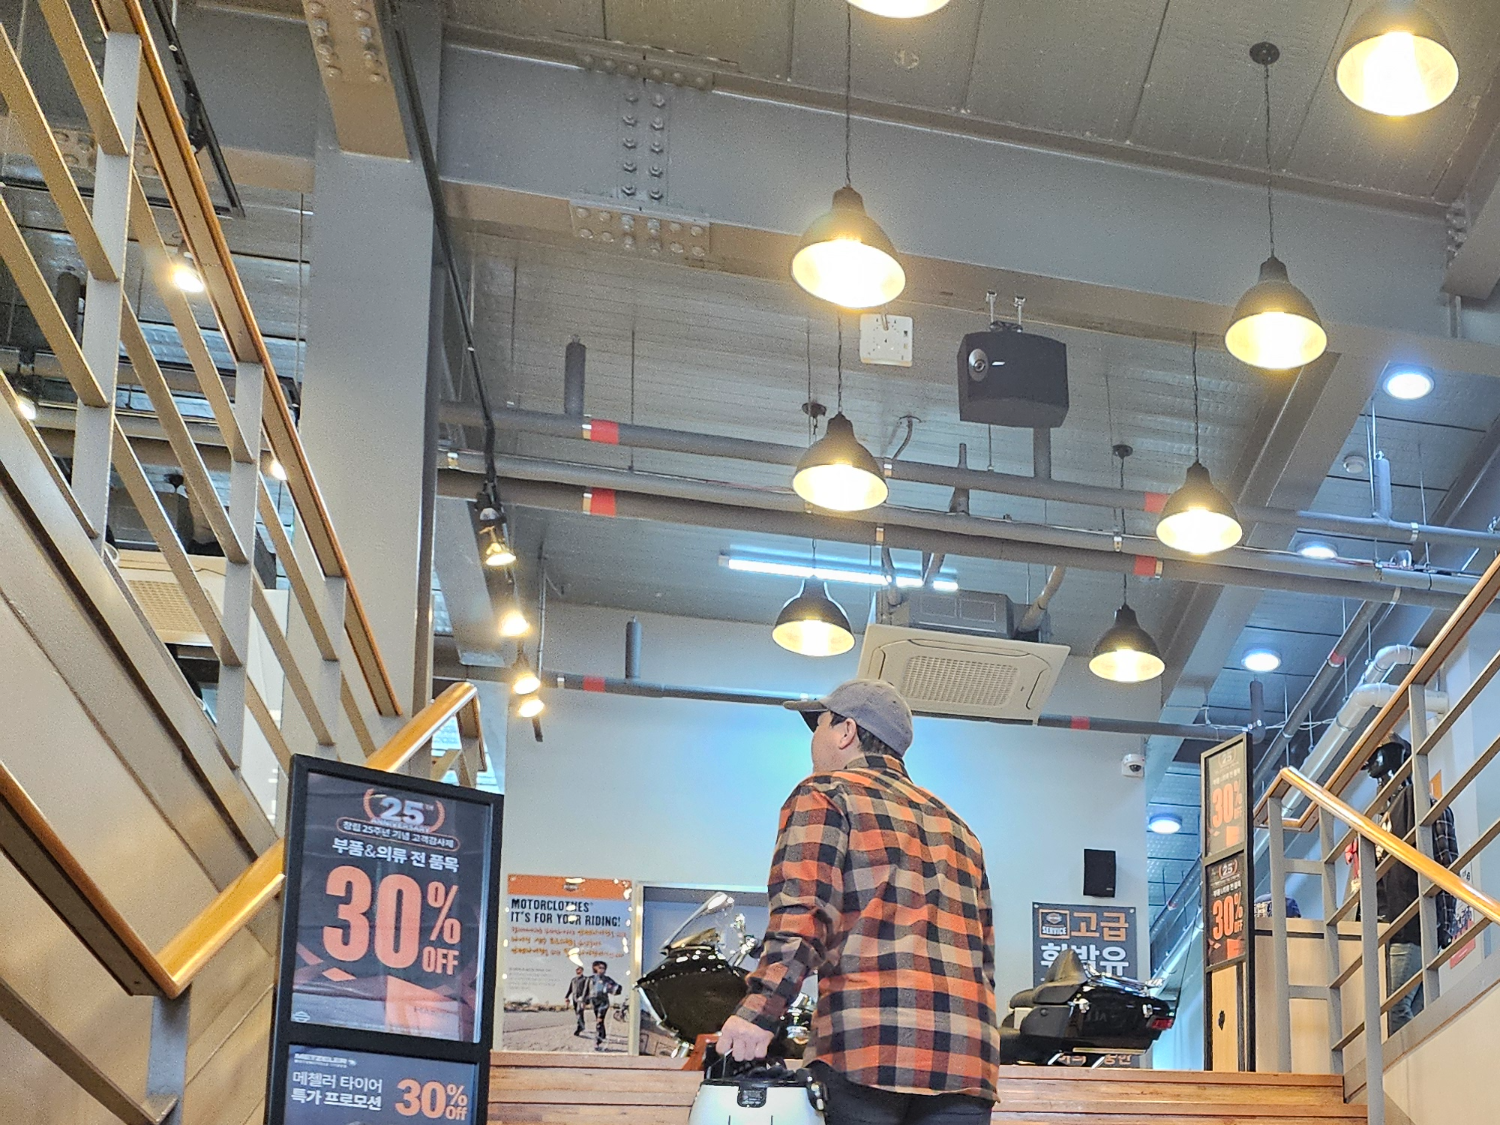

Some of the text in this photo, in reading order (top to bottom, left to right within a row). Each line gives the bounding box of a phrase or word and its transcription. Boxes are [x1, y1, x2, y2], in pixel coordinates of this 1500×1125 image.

[1212, 780, 1242, 828] 30%
[332, 838, 459, 873] 부품&의류 전 품목
[322, 866, 461, 968] 30%
[511, 911, 531, 923] IT'S
[534, 912, 552, 924] FOR
[585, 915, 621, 927] RIDING!
[1042, 926, 1067, 935] SERVICE
[1071, 911, 1129, 941] 고급
[1213, 892, 1243, 940] 30%
[422, 946, 459, 975] OFF
[292, 1071, 383, 1093] 메첼러 타이어
[291, 1088, 382, 1111] 특가 프로모션
[395, 1078, 468, 1120] 30%
[446, 1104, 467, 1121] Off
